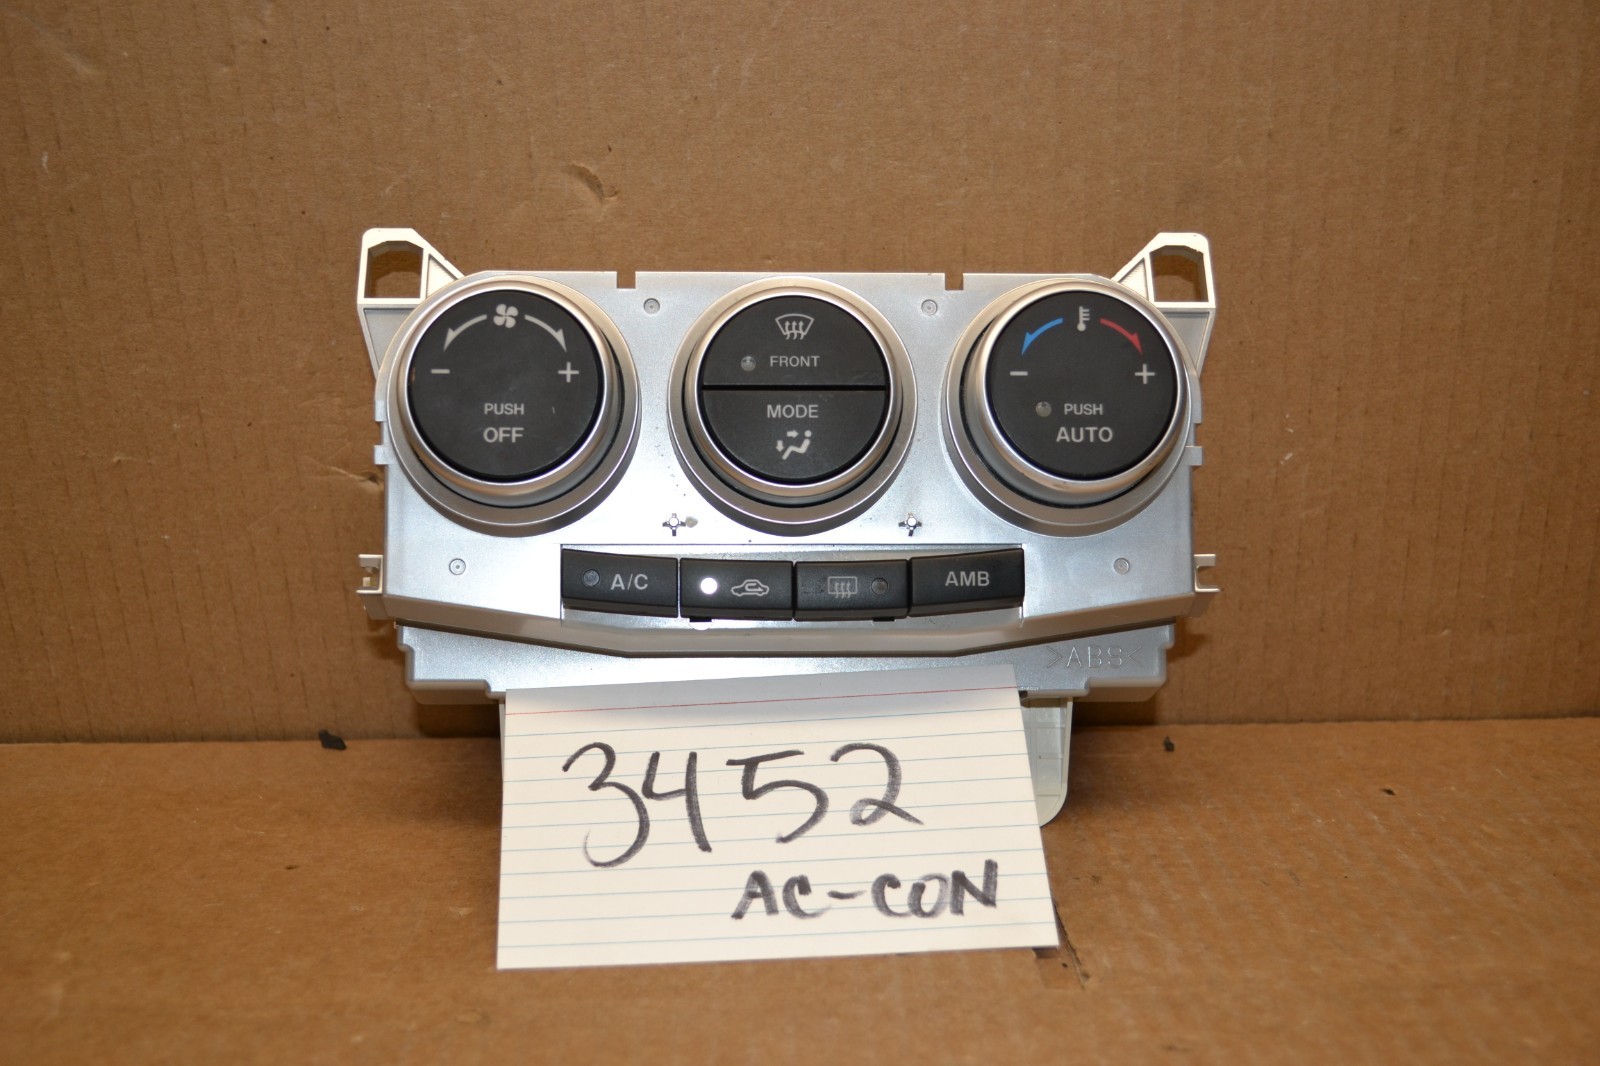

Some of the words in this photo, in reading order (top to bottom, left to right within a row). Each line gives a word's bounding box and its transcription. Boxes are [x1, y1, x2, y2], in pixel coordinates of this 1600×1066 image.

[769, 355, 820, 368] FRONT
[483, 402, 525, 416] PUSH
[766, 404, 819, 419] MODE
[1063, 402, 1104, 416] PUSH
[482, 426, 525, 443] OFF
[1055, 426, 1114, 443] AUTO
[610, 572, 649, 591] A/C
[944, 570, 991, 588] AMB
[561, 741, 925, 868] 3452
[730, 858, 999, 920] AC-CON
